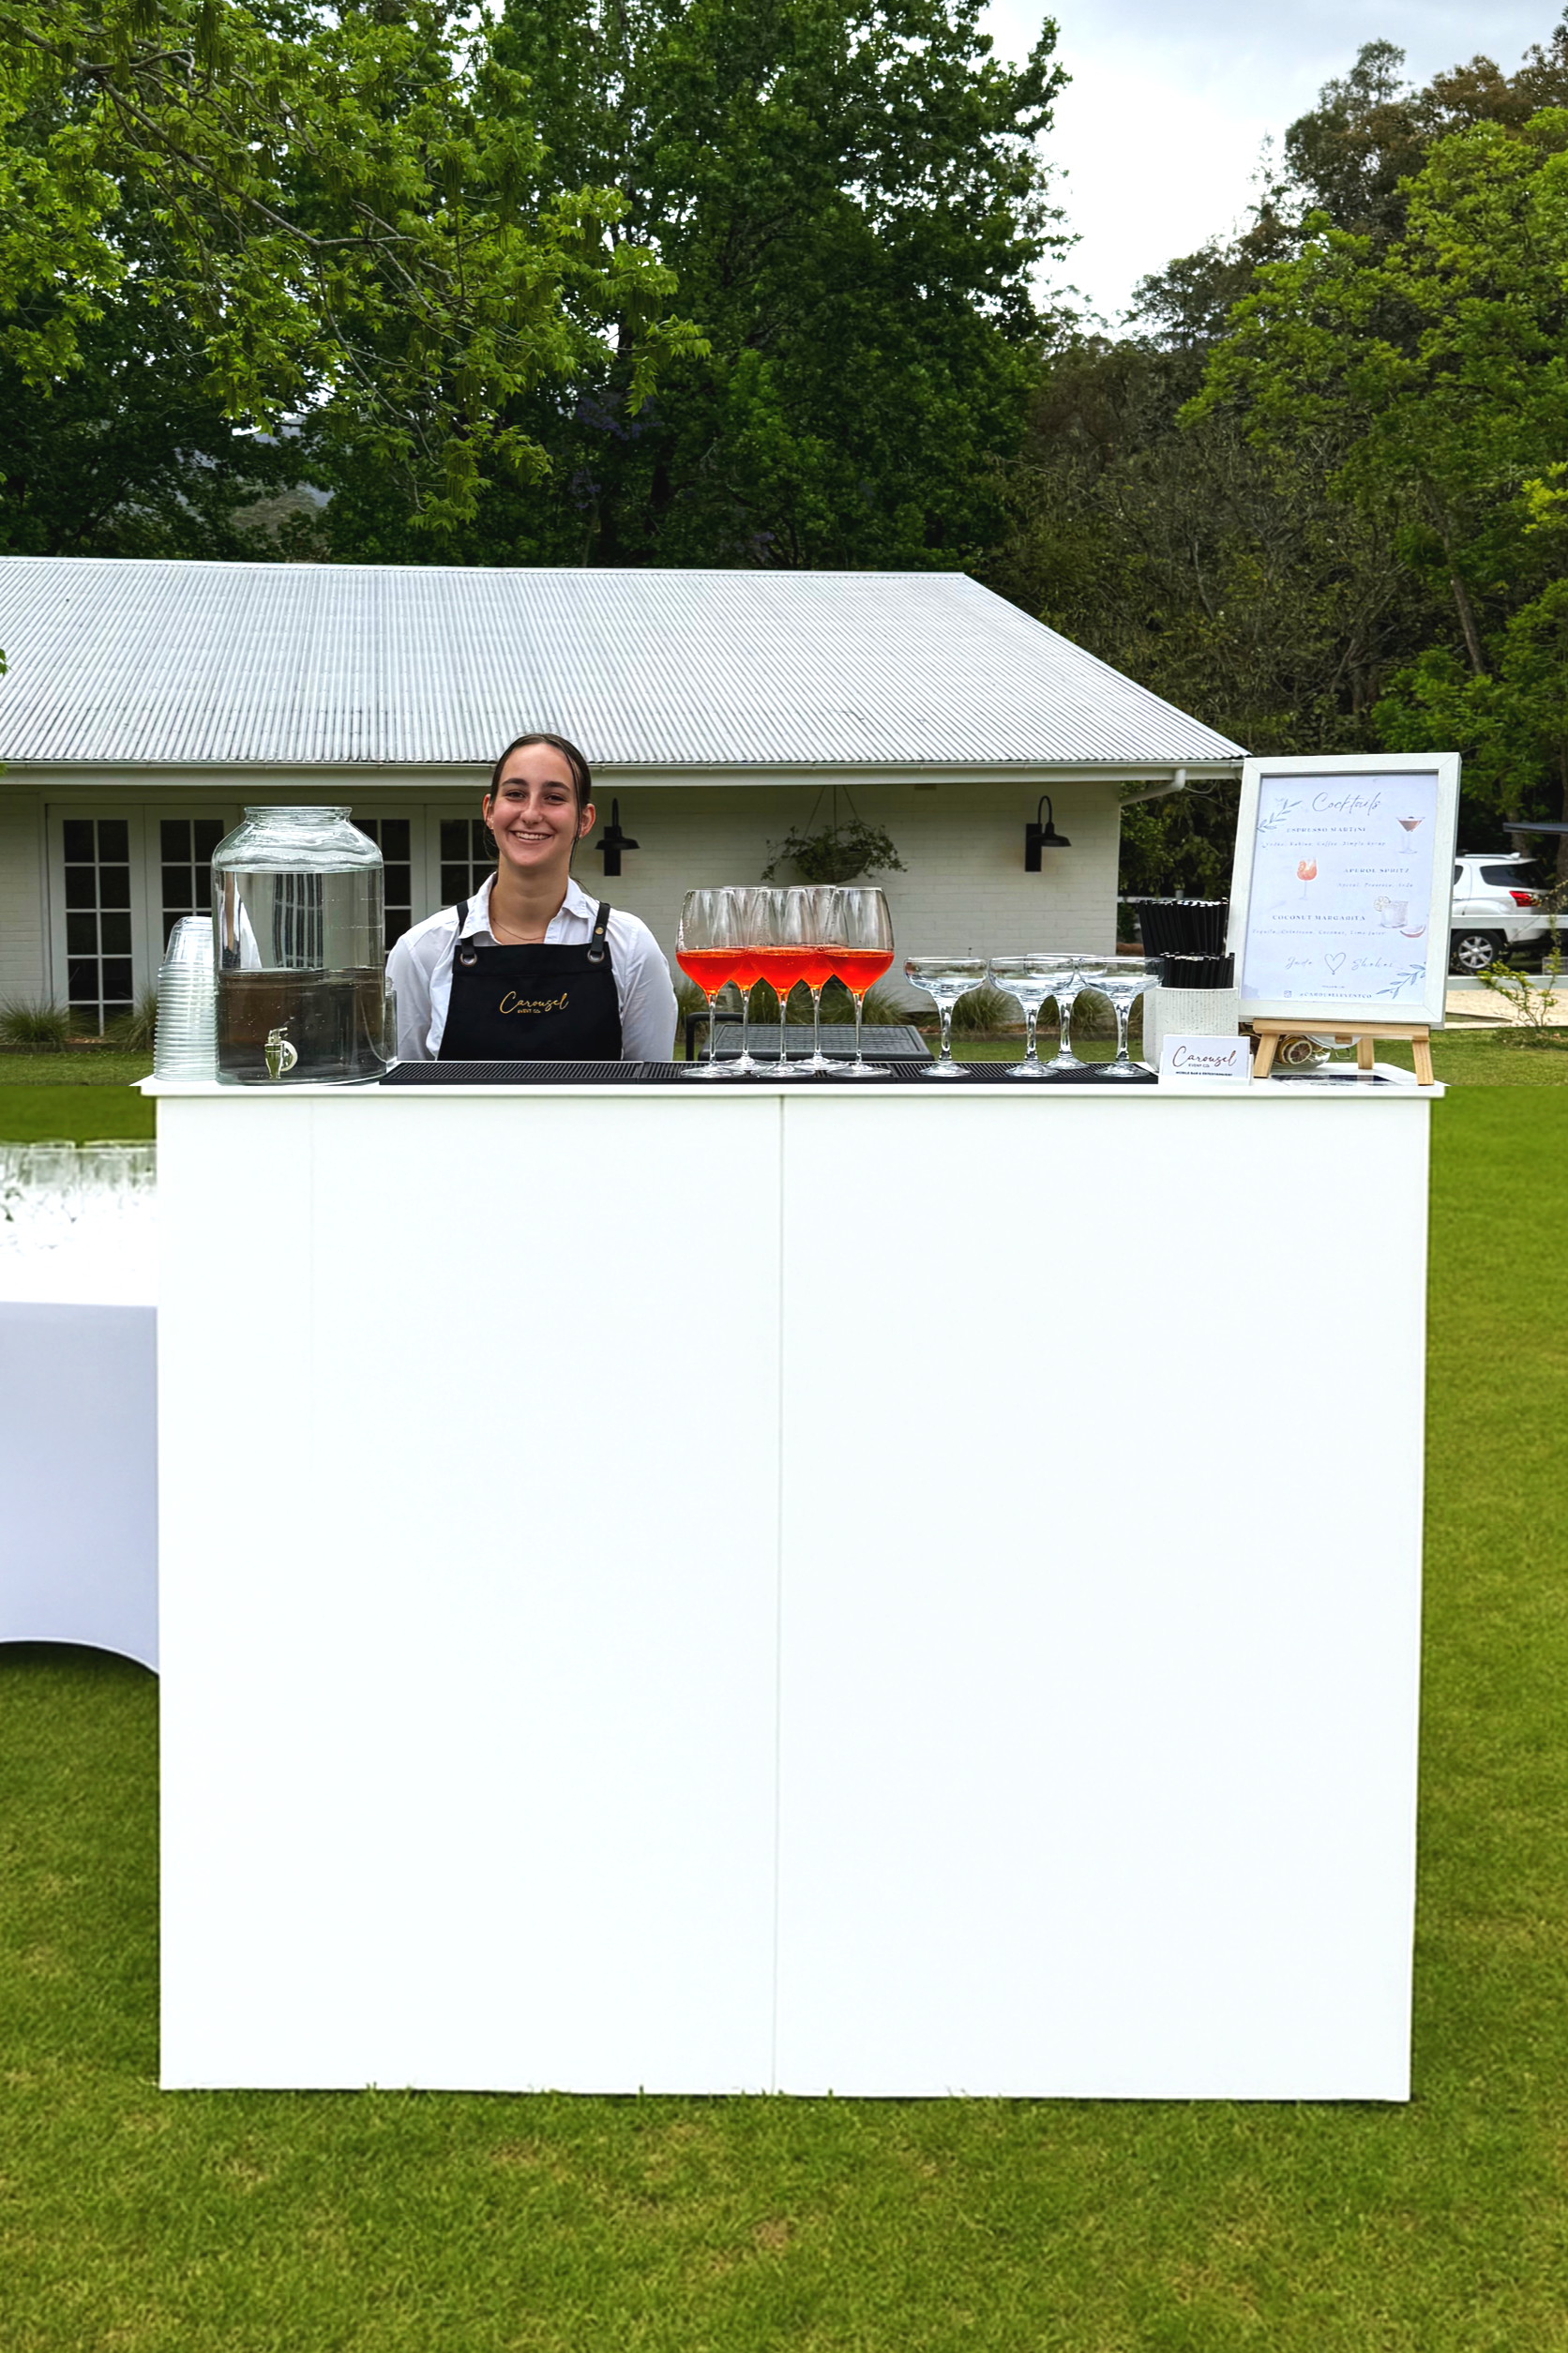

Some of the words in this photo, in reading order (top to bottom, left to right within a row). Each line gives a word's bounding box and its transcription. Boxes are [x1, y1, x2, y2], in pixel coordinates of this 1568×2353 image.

[1312, 792, 1382, 816] Cocktails
[499, 990, 569, 1015] Carousel
[1172, 1046, 1238, 1067] Carousel
